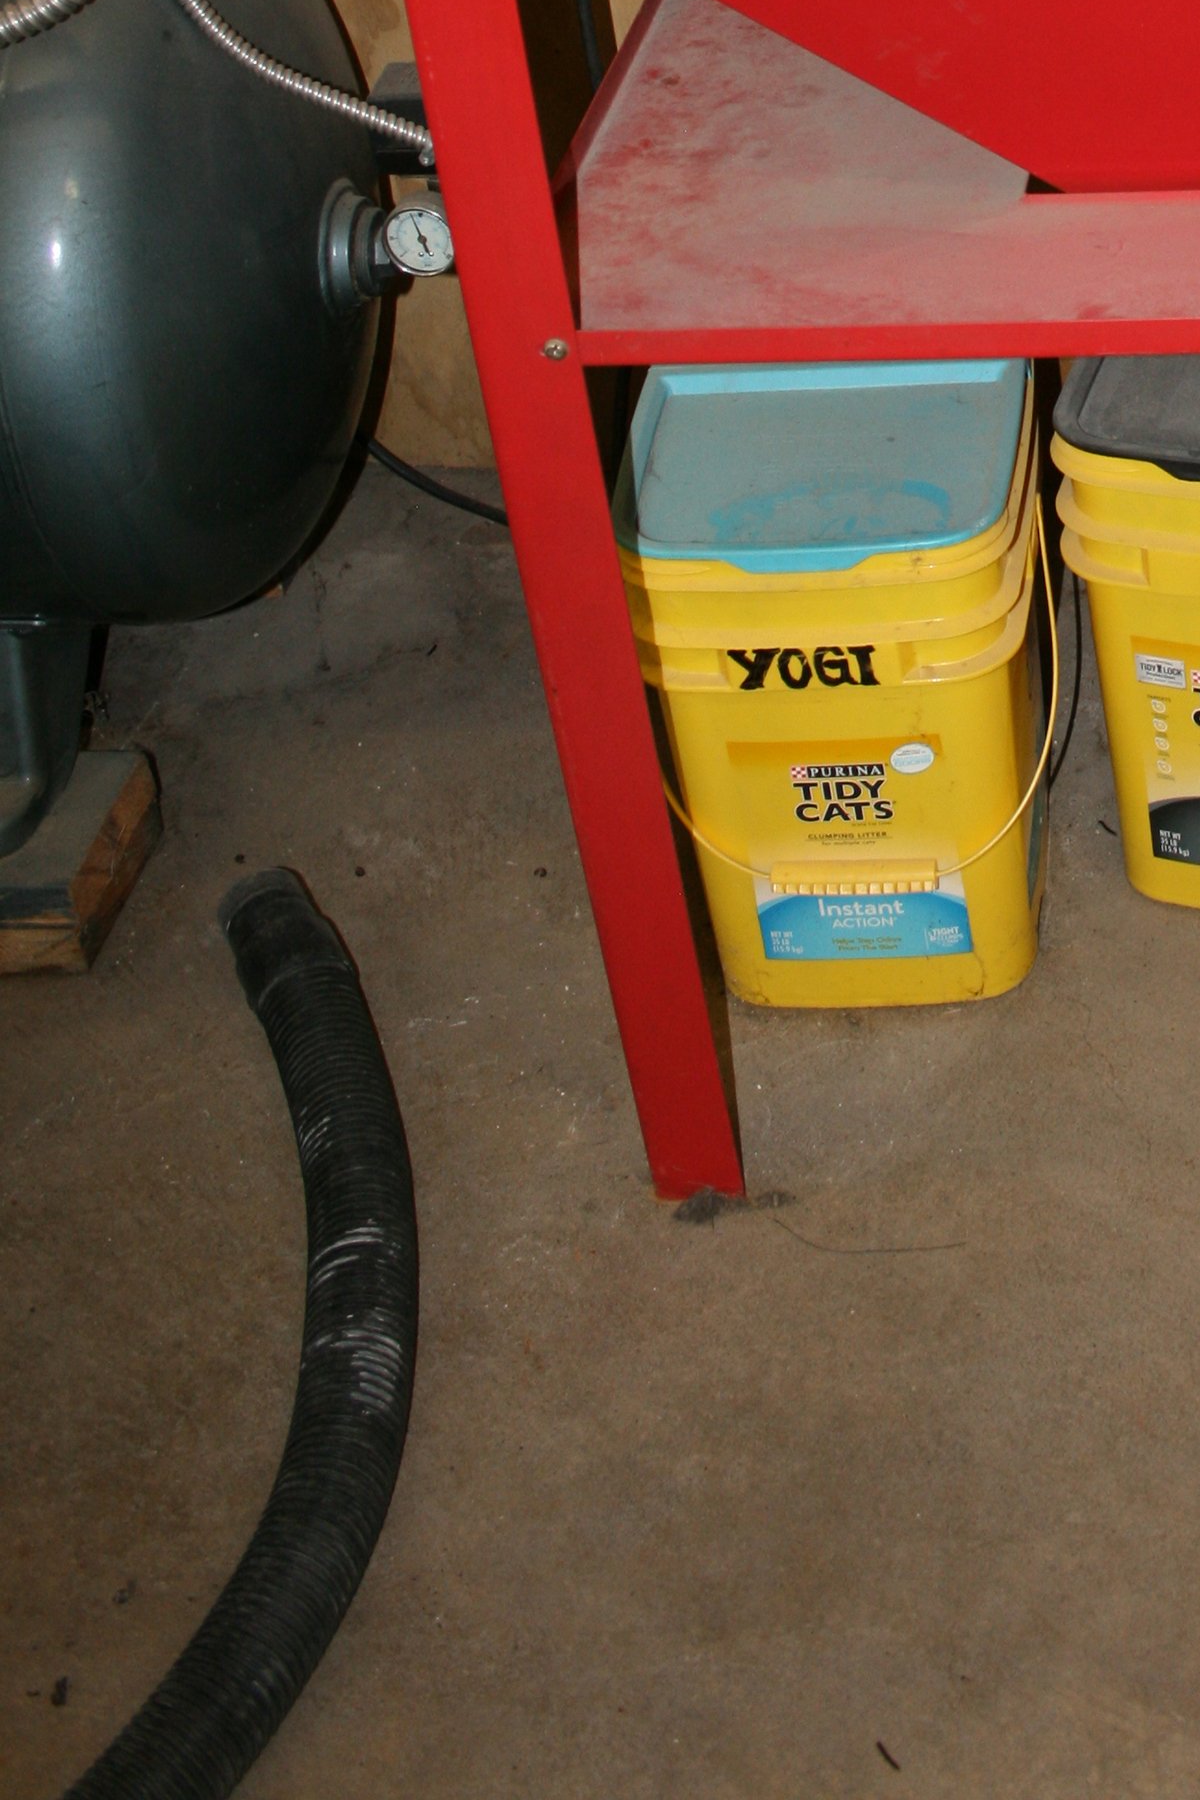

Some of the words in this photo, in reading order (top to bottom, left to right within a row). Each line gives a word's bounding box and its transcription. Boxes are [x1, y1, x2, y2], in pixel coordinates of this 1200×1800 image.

[727, 644, 881, 690] YOGI
[1140, 662, 1155, 672] TIDY
[1163, 666, 1183, 676] LOCK
[809, 765, 882, 777] PURINA
[793, 780, 884, 800] TIDY
[795, 801, 893, 821] CATS
[808, 832, 854, 840] CLUMPING
[818, 898, 905, 917] Instant
[832, 917, 894, 929] ACTION
